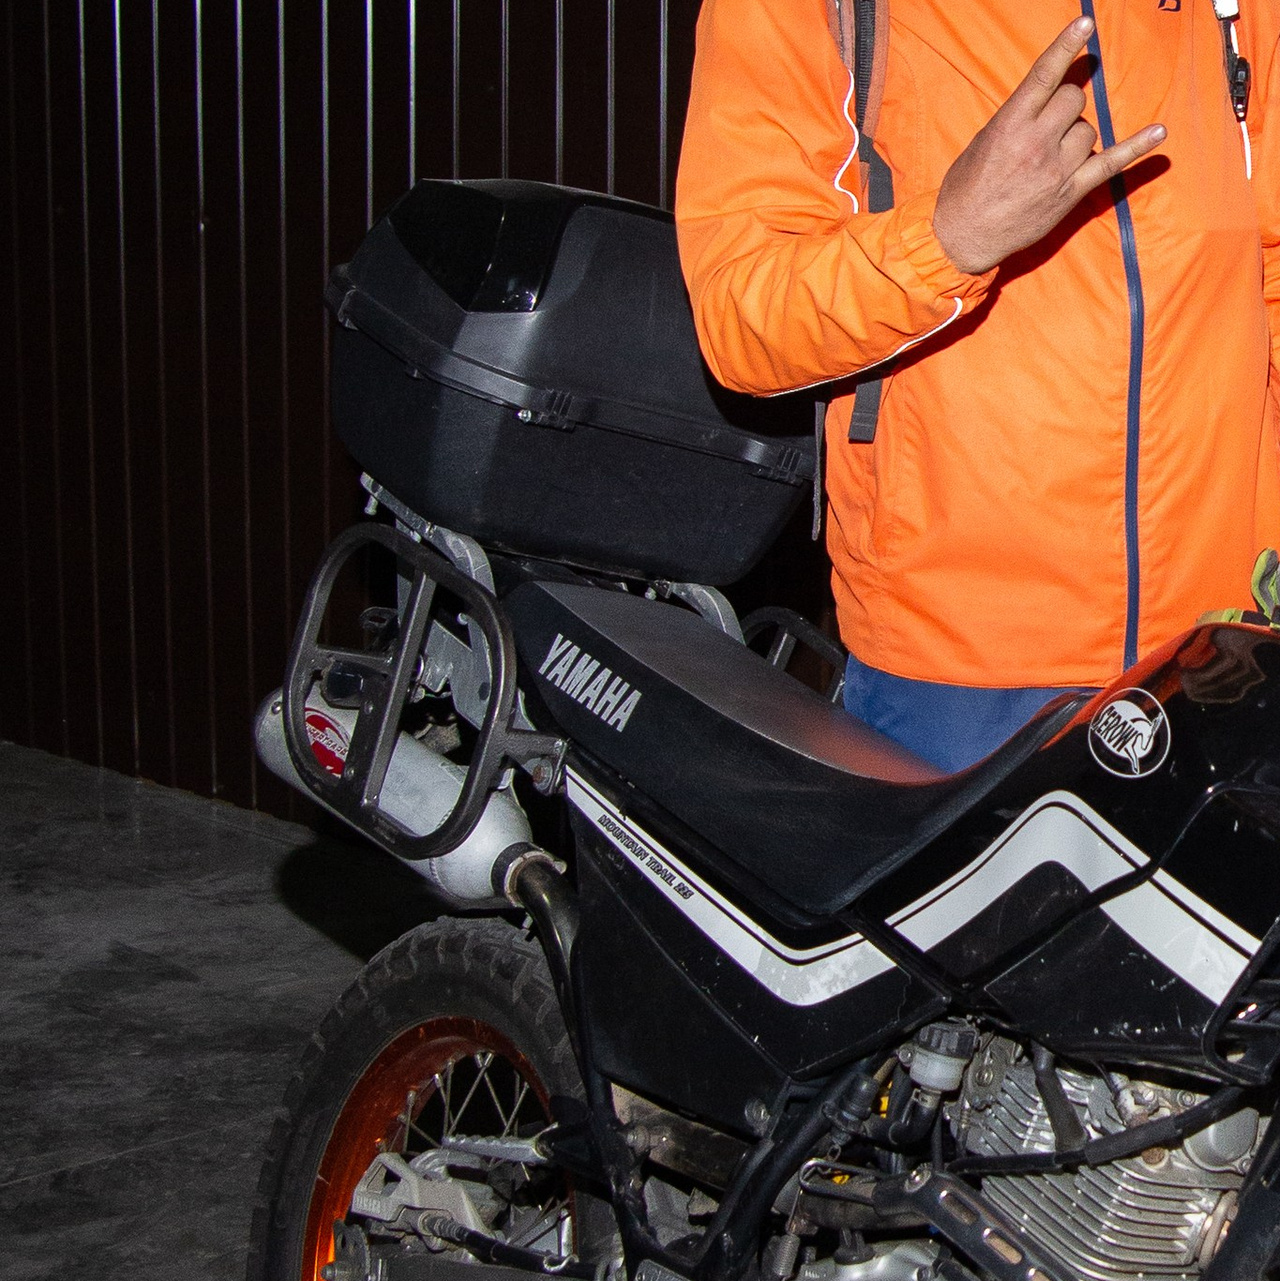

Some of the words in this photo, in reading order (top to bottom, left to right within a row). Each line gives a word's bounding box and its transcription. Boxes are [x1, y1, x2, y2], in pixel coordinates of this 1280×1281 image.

[538, 633, 642, 732] YAMAHA
[1092, 705, 1139, 753] SEROW
[597, 814, 650, 862] MOUNTAIN
[645, 856, 677, 887] TRAIL
[673, 882, 695, 900] 225
